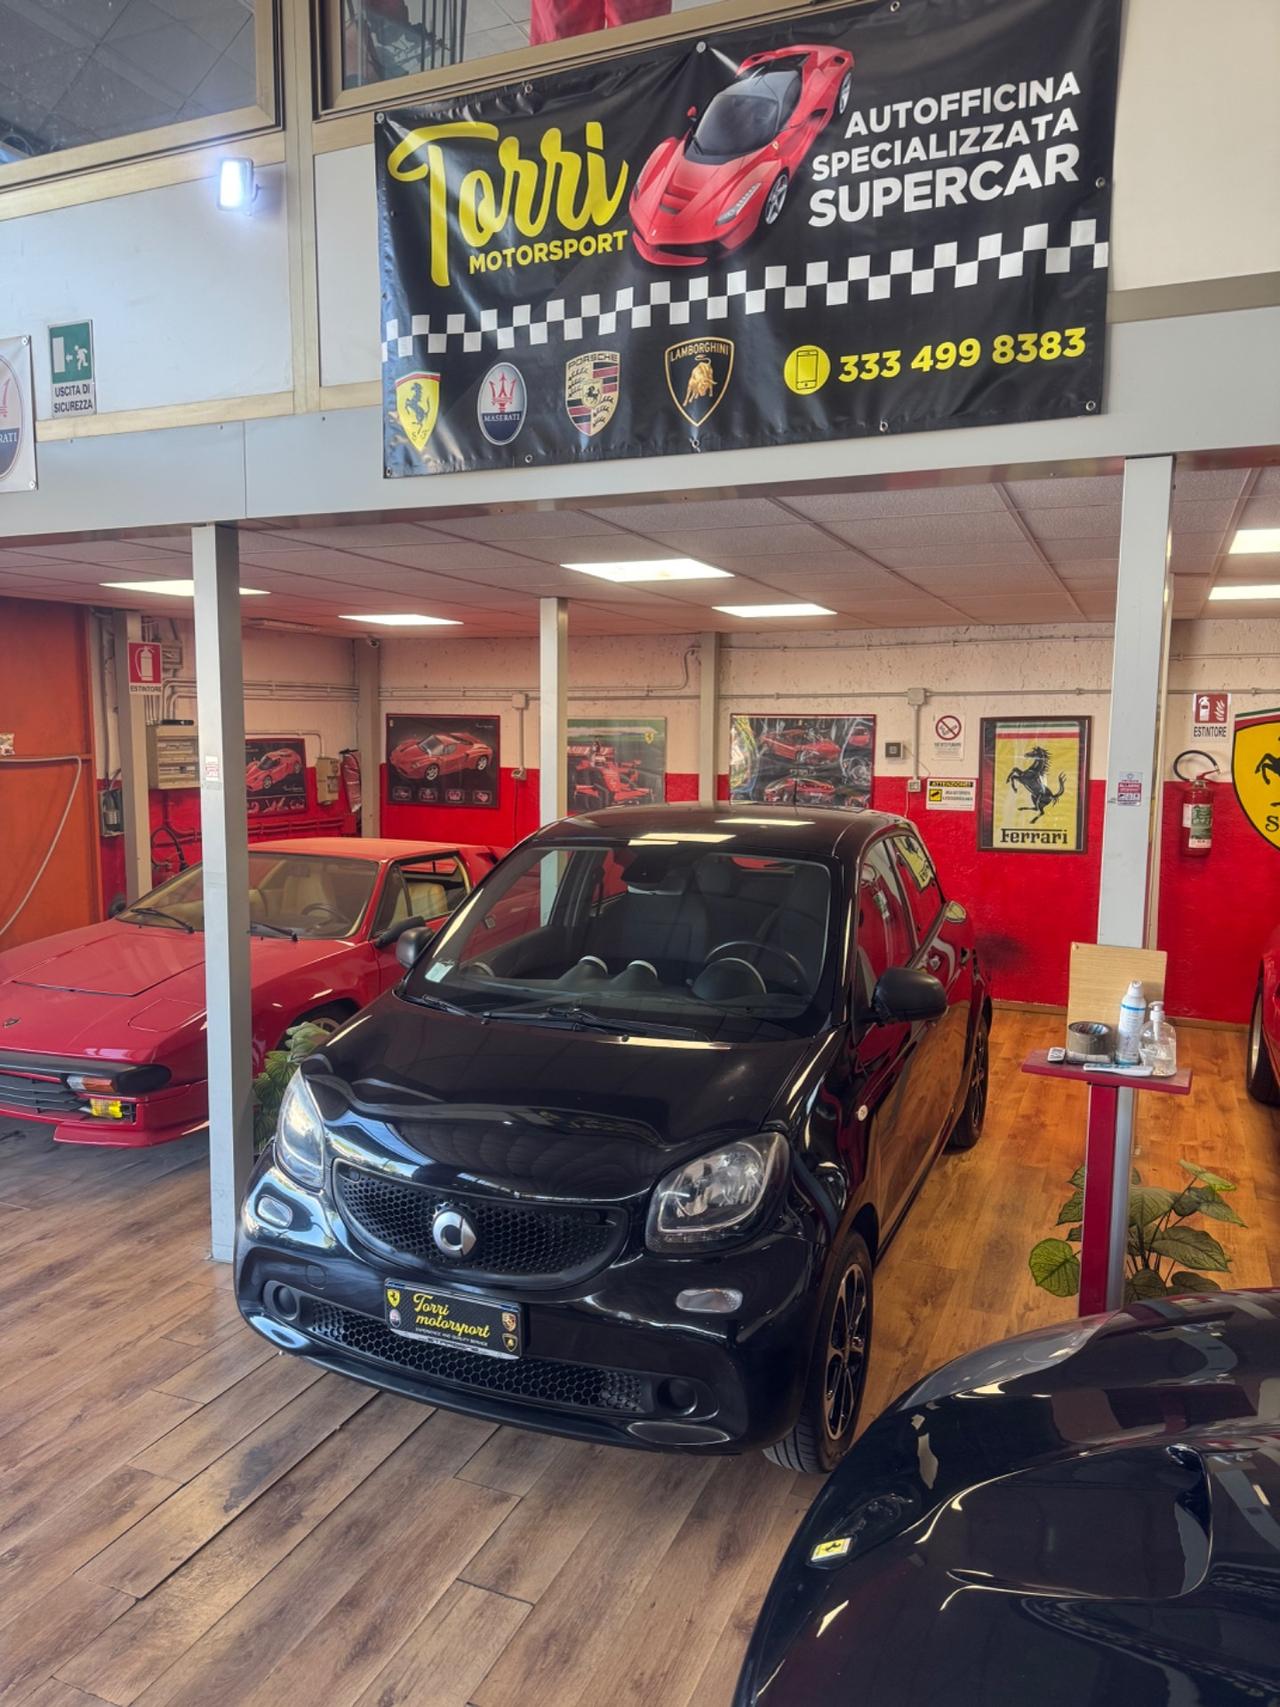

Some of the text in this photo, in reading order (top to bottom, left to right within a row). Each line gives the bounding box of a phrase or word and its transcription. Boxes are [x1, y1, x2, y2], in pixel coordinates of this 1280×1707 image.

[845, 71, 1081, 139] AUTOFFICINA
[811, 107, 1079, 181] SPECIALIZZATA
[808, 143, 1080, 228] SUPERCAR
[387, 121, 629, 287] Torri
[468, 230, 628, 275] MOTORSPORT
[568, 352, 619, 371] PORSCHE
[670, 342, 729, 362] LAMBORGHINI
[838, 327, 1086, 383] 333 499 8383
[55, 383, 91, 397] USCITA DI
[53, 399, 93, 413] SICUREZZA
[484, 413, 520, 422] MASERATI
[1193, 726, 1227, 738] ESTINTORE
[1000, 828, 1069, 845] Ferrari
[414, 1293, 449, 1315] Torri
[415, 1315, 490, 1338] motorsport
